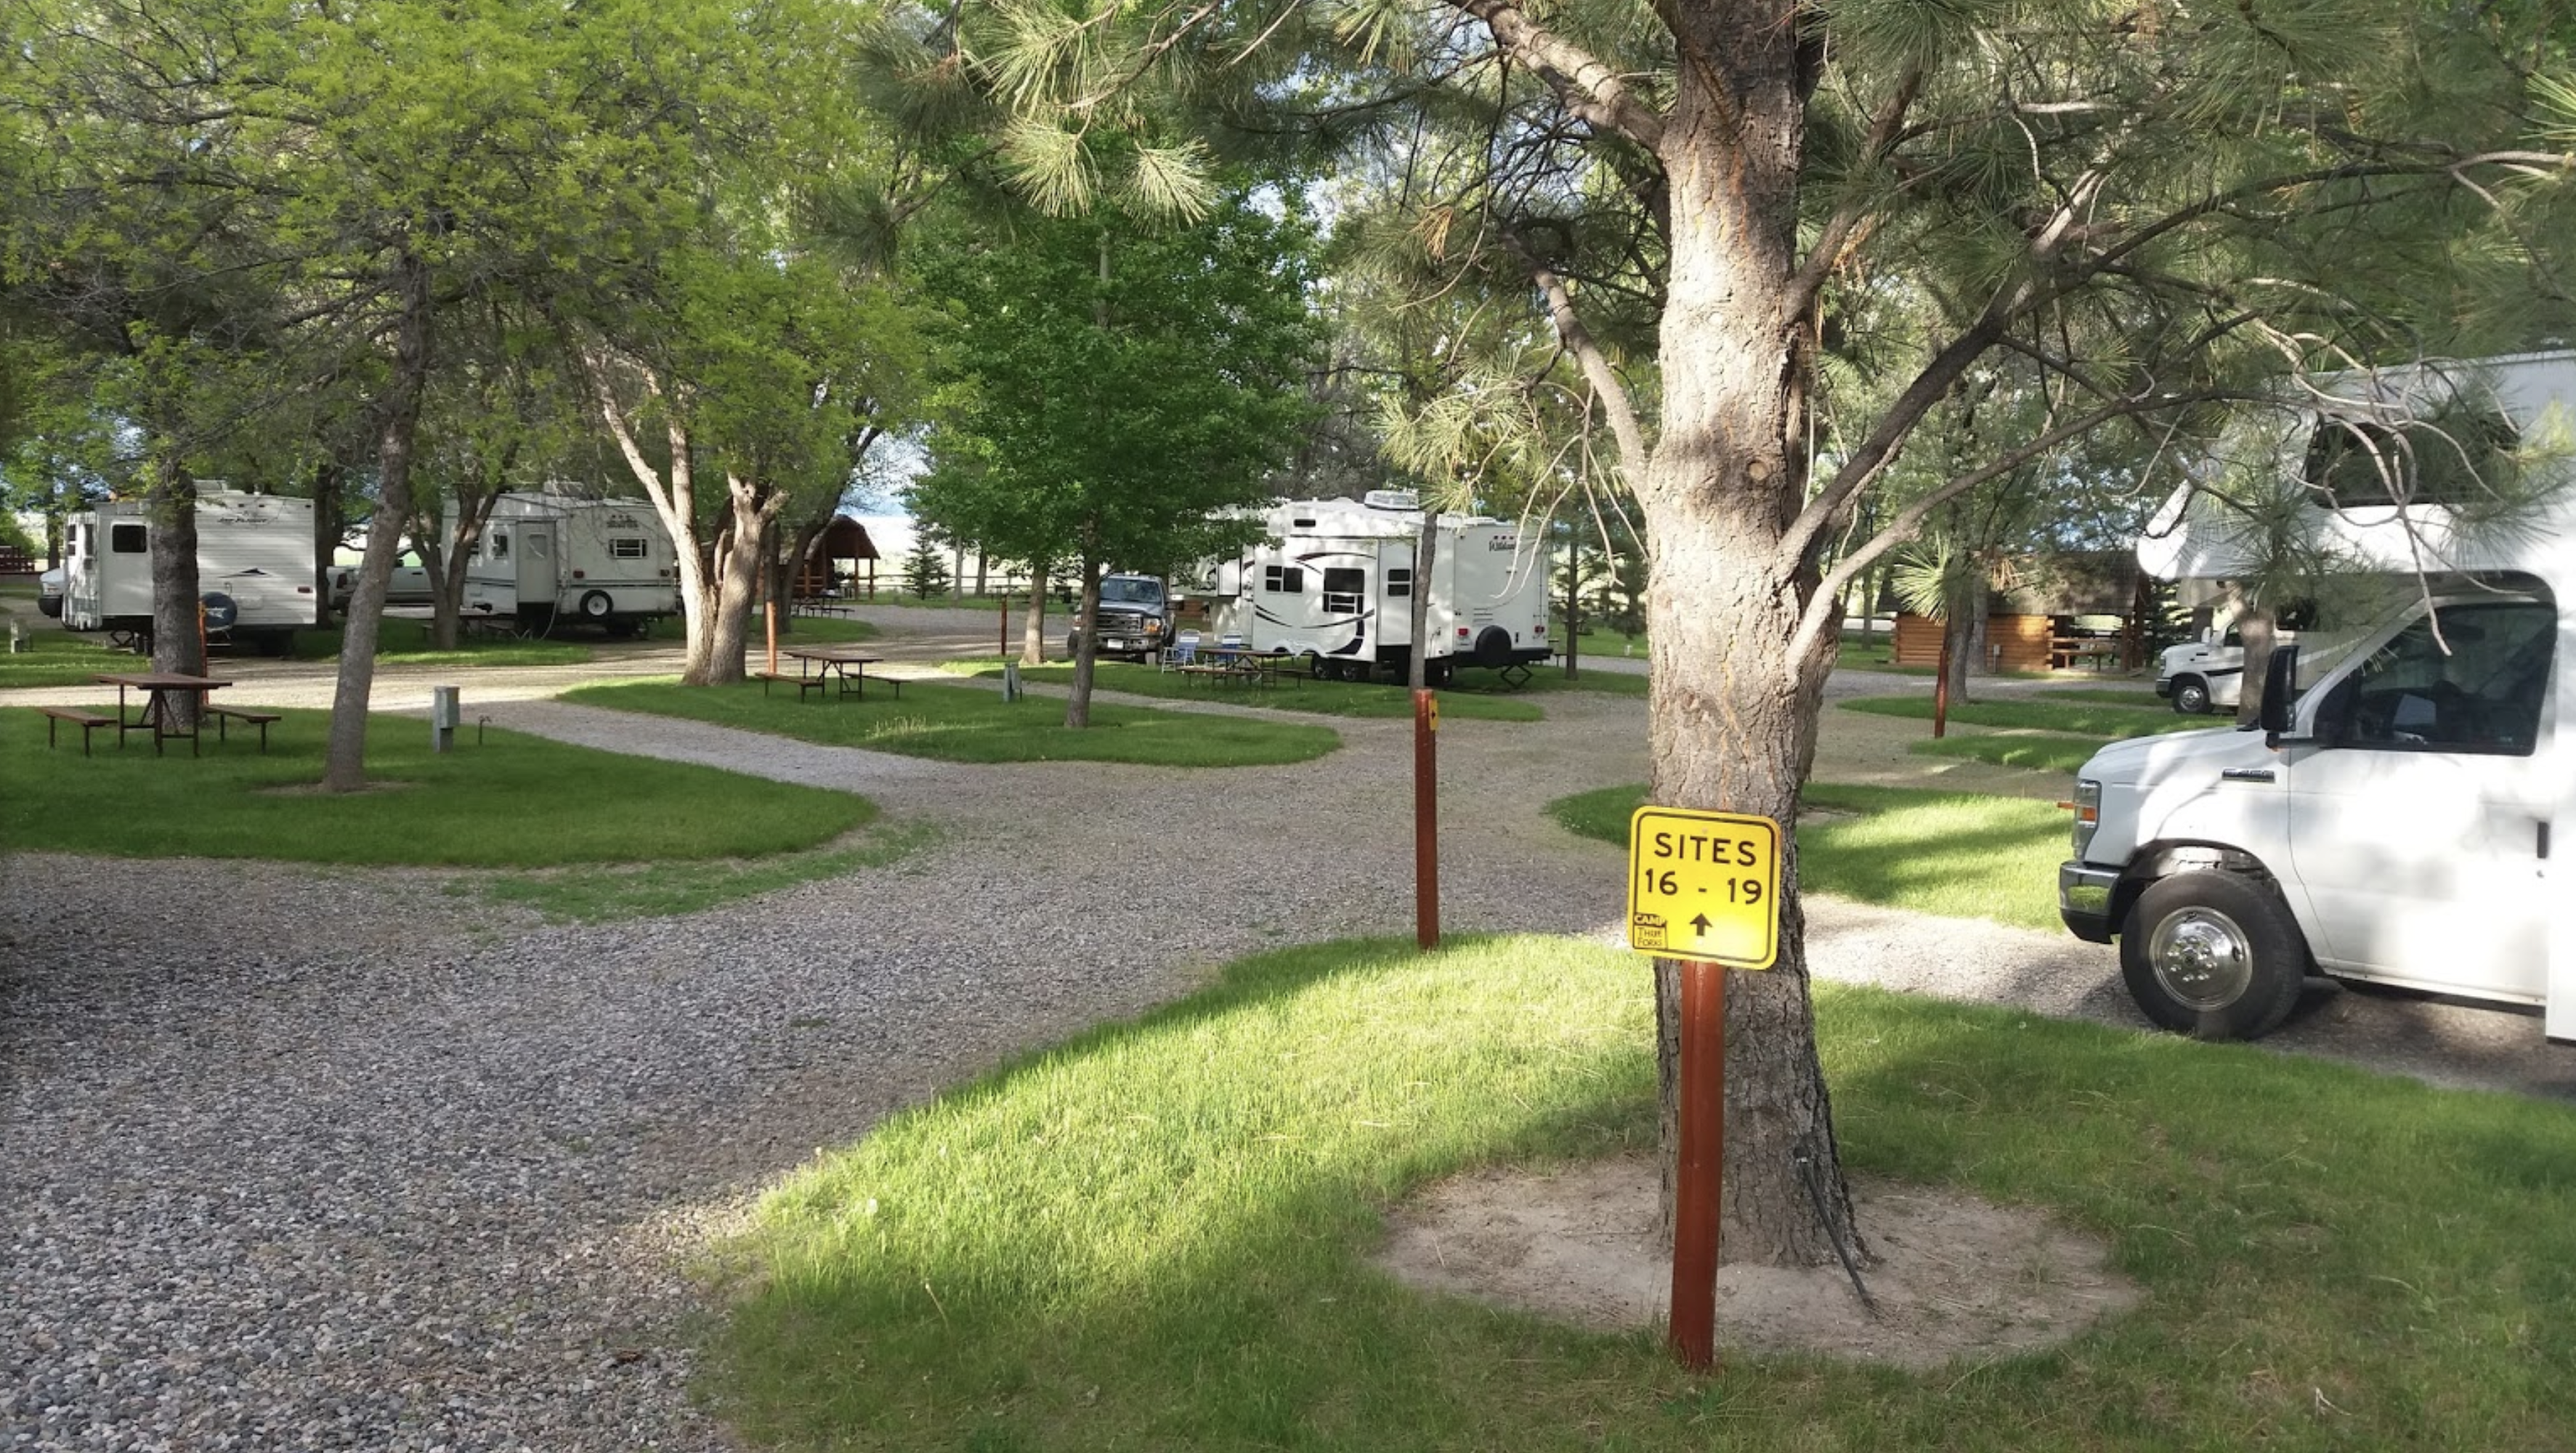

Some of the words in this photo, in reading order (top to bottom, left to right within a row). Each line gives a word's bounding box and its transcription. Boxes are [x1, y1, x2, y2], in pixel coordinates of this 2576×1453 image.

[1654, 833, 1757, 867] SITES
[1645, 868, 1678, 896] 16
[1727, 878, 1762, 905] 19
[1635, 915, 1665, 926] CAMP
